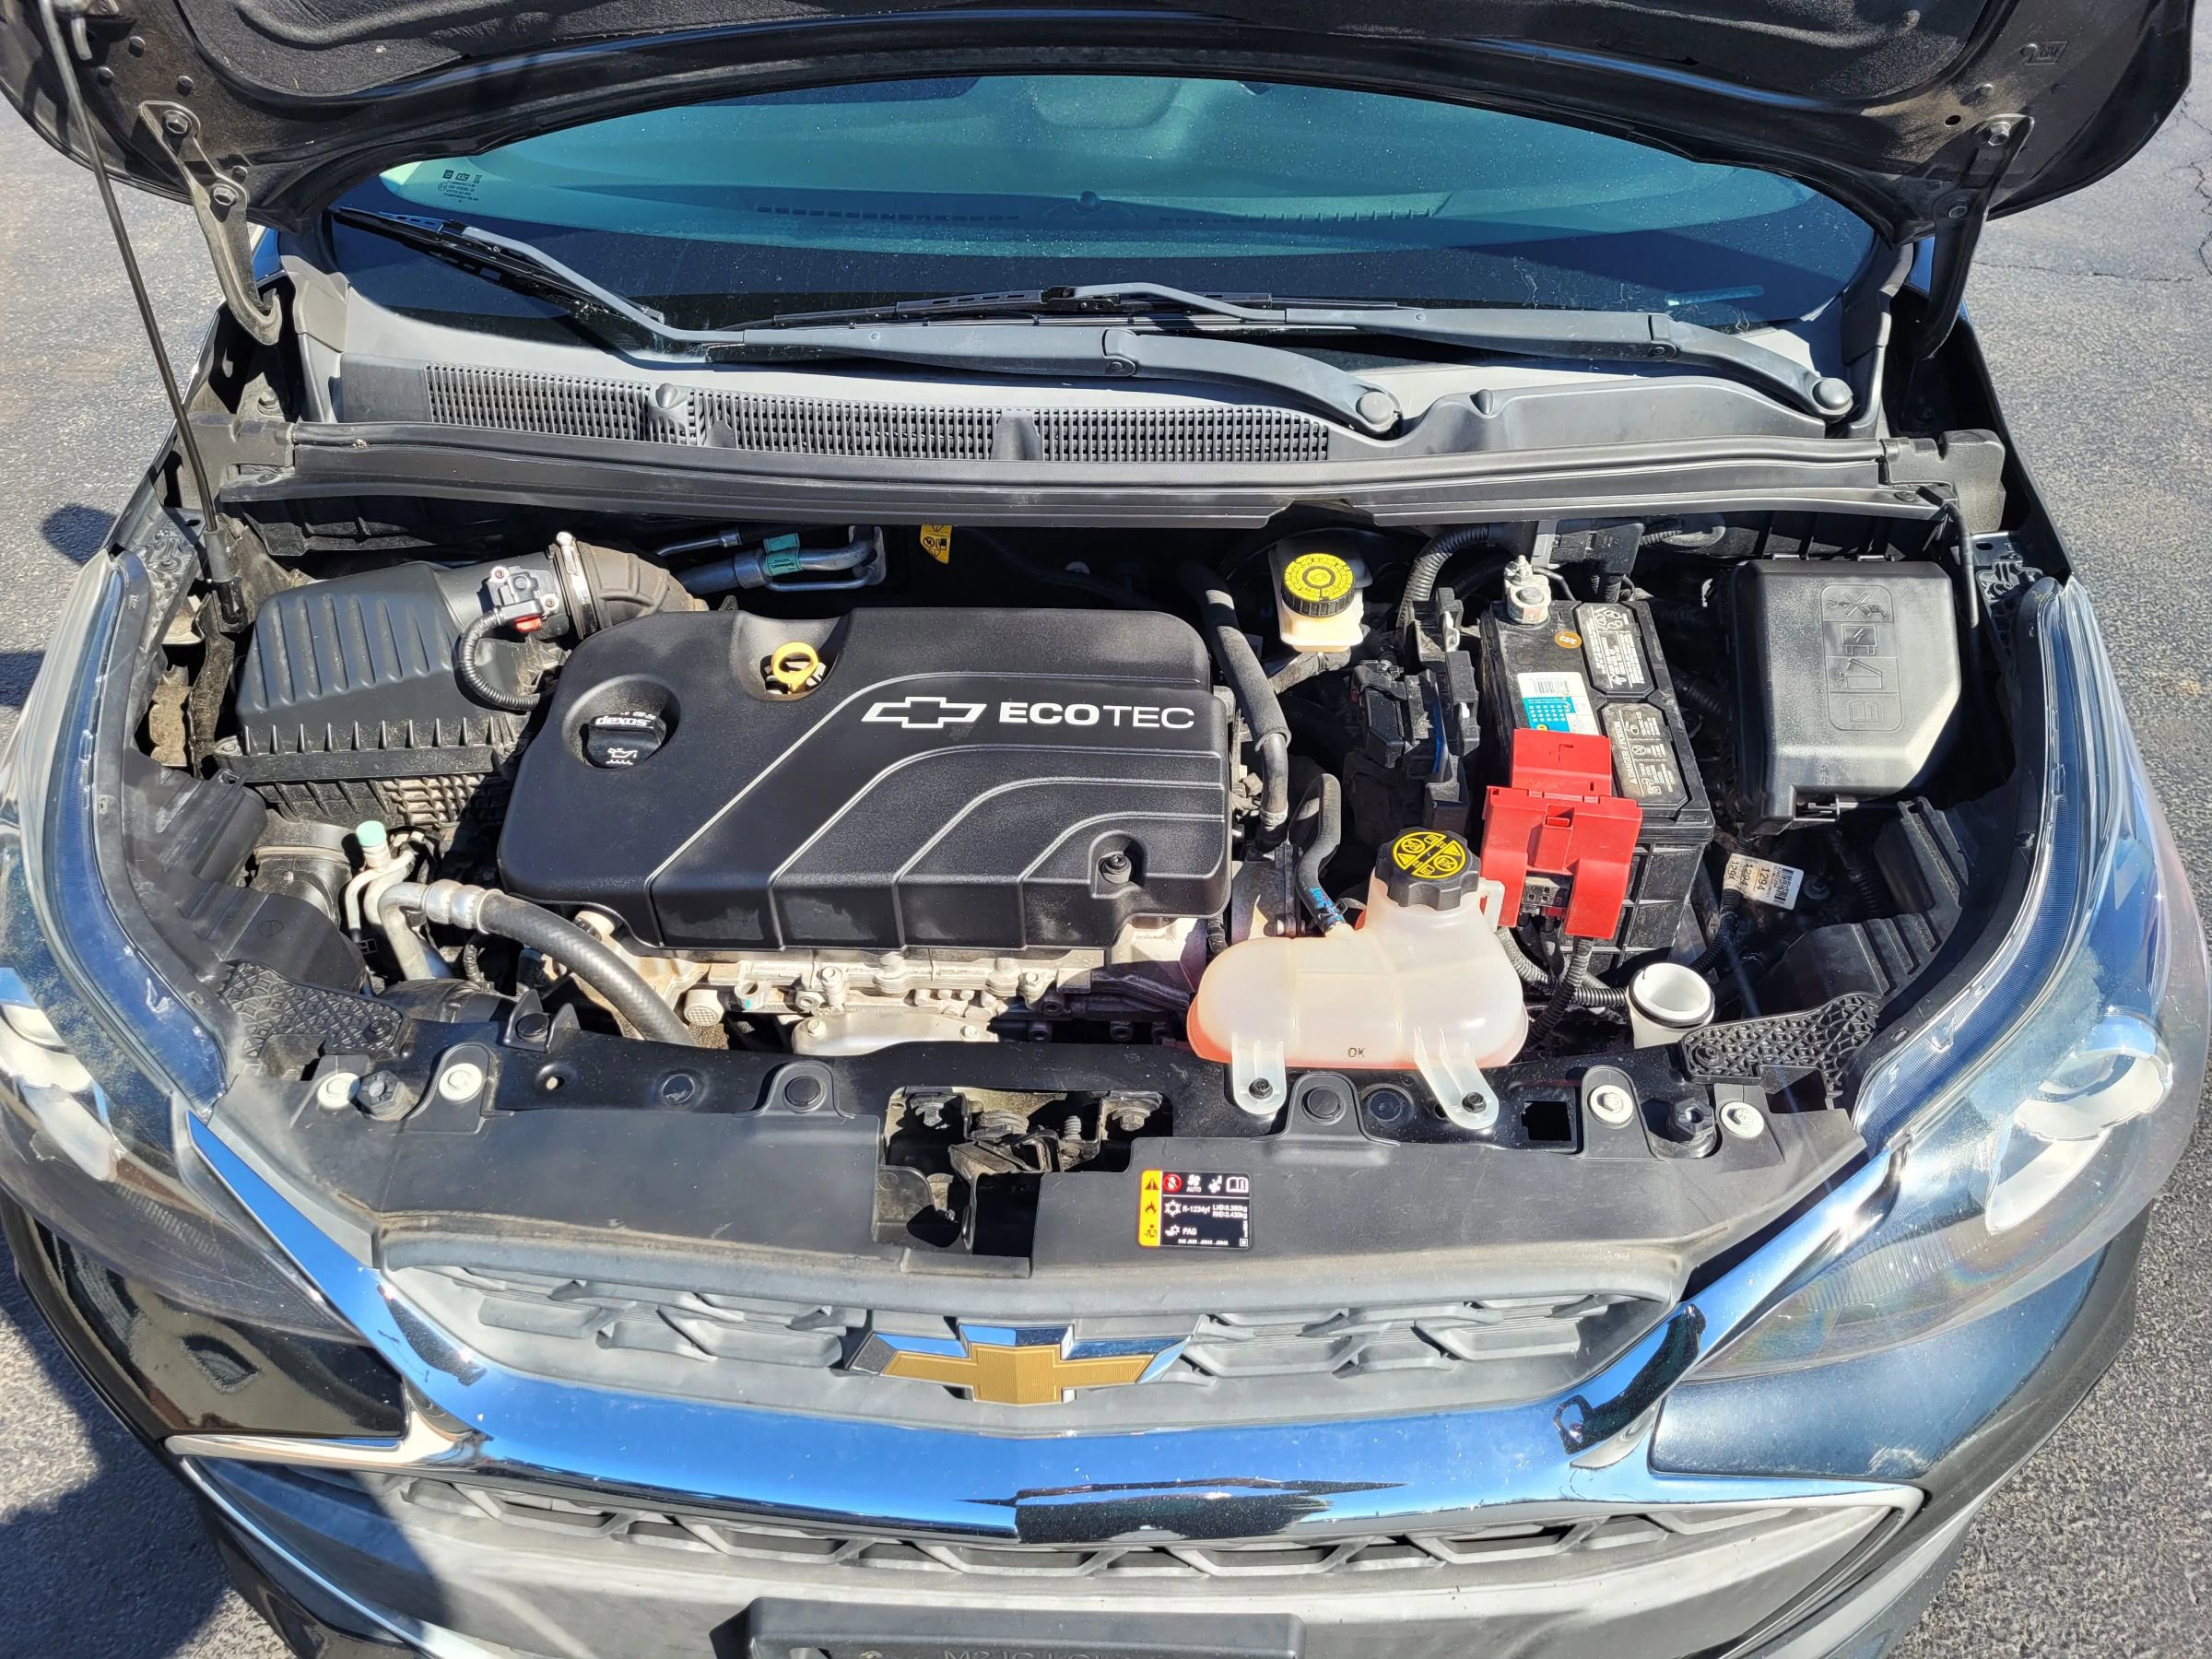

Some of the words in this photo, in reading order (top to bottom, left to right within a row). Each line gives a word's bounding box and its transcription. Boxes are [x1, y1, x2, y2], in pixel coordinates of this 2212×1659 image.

[998, 701, 1194, 729] ECOTEC
[1613, 721, 1628, 746] POISON
[1622, 750, 1635, 778] DANGER
[1740, 863, 1754, 887] 1294
[1756, 865, 1771, 891] 1294
[1347, 1047, 1365, 1058] OK
[1182, 1227, 1197, 1236] PAG
